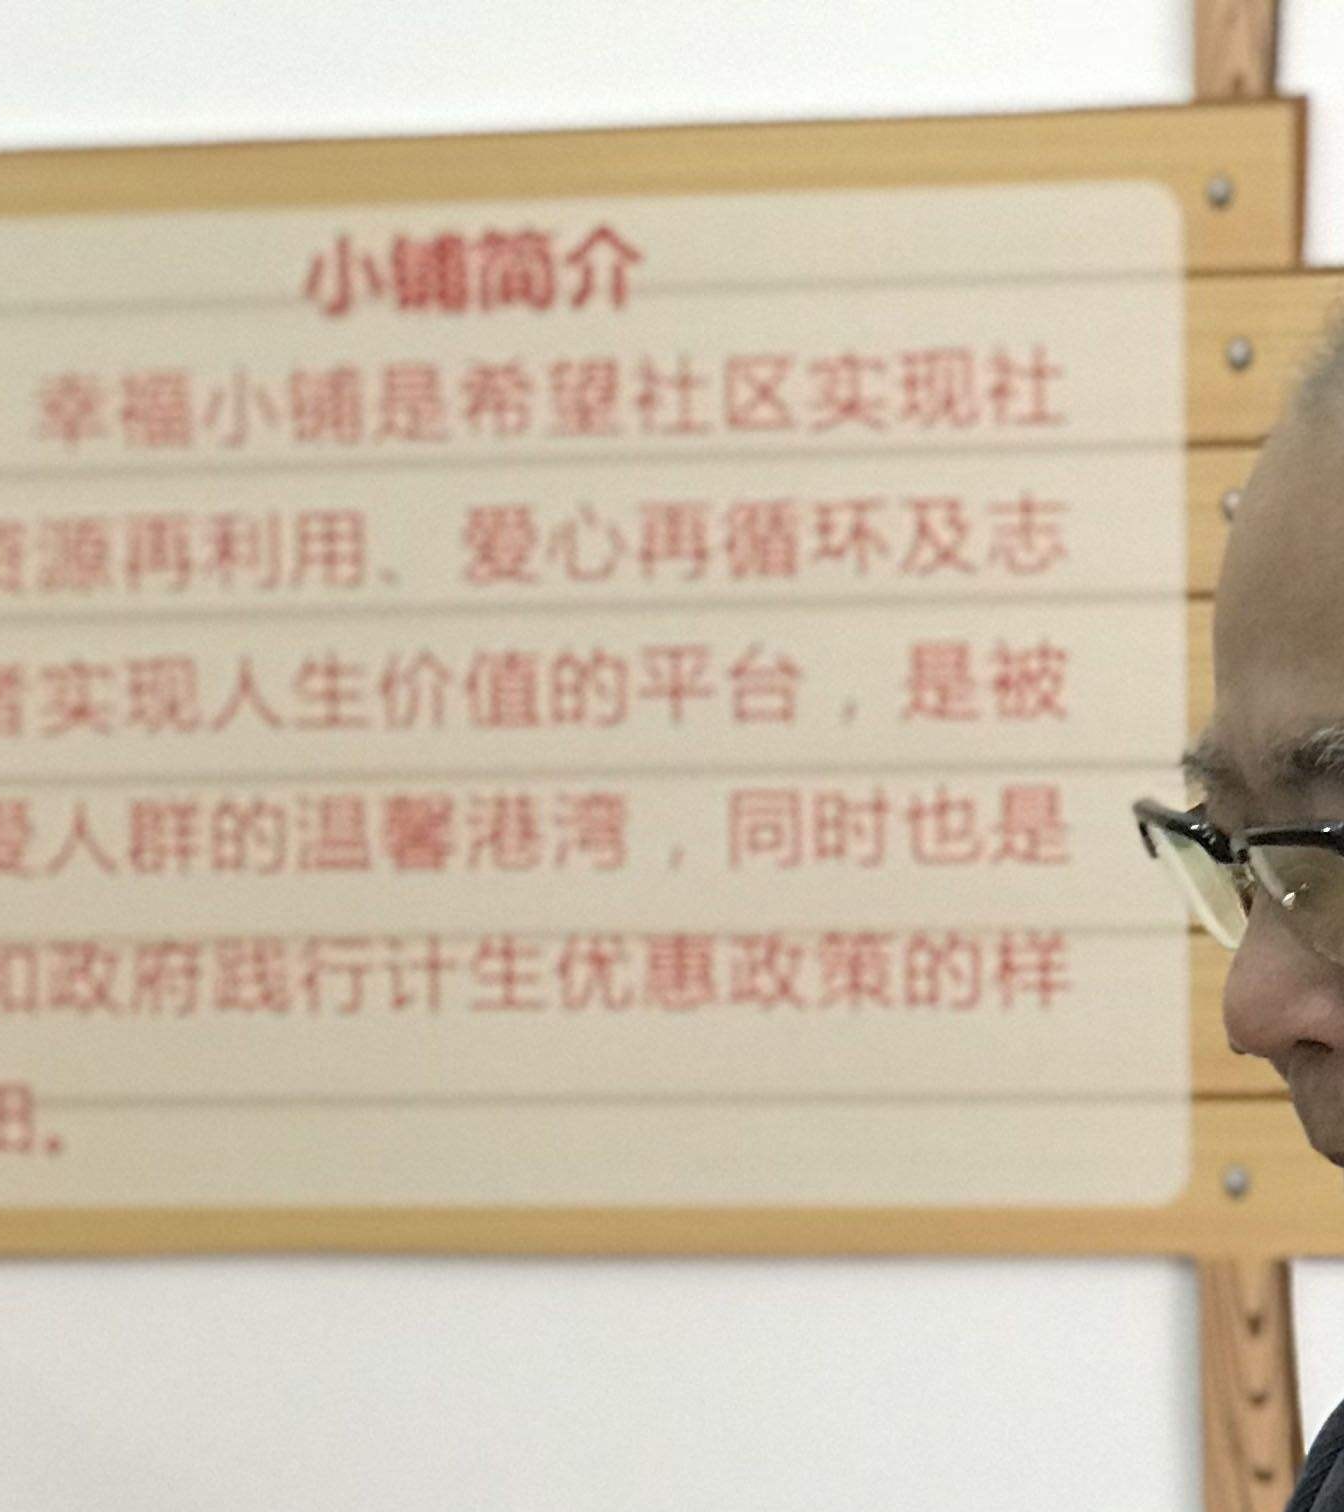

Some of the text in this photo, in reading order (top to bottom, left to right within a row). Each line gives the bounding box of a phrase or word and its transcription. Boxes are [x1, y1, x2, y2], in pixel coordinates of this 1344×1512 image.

[301, 224, 643, 317] 小铺简介
[36, 345, 1068, 449] 幸福小铺是希望社区实现社
